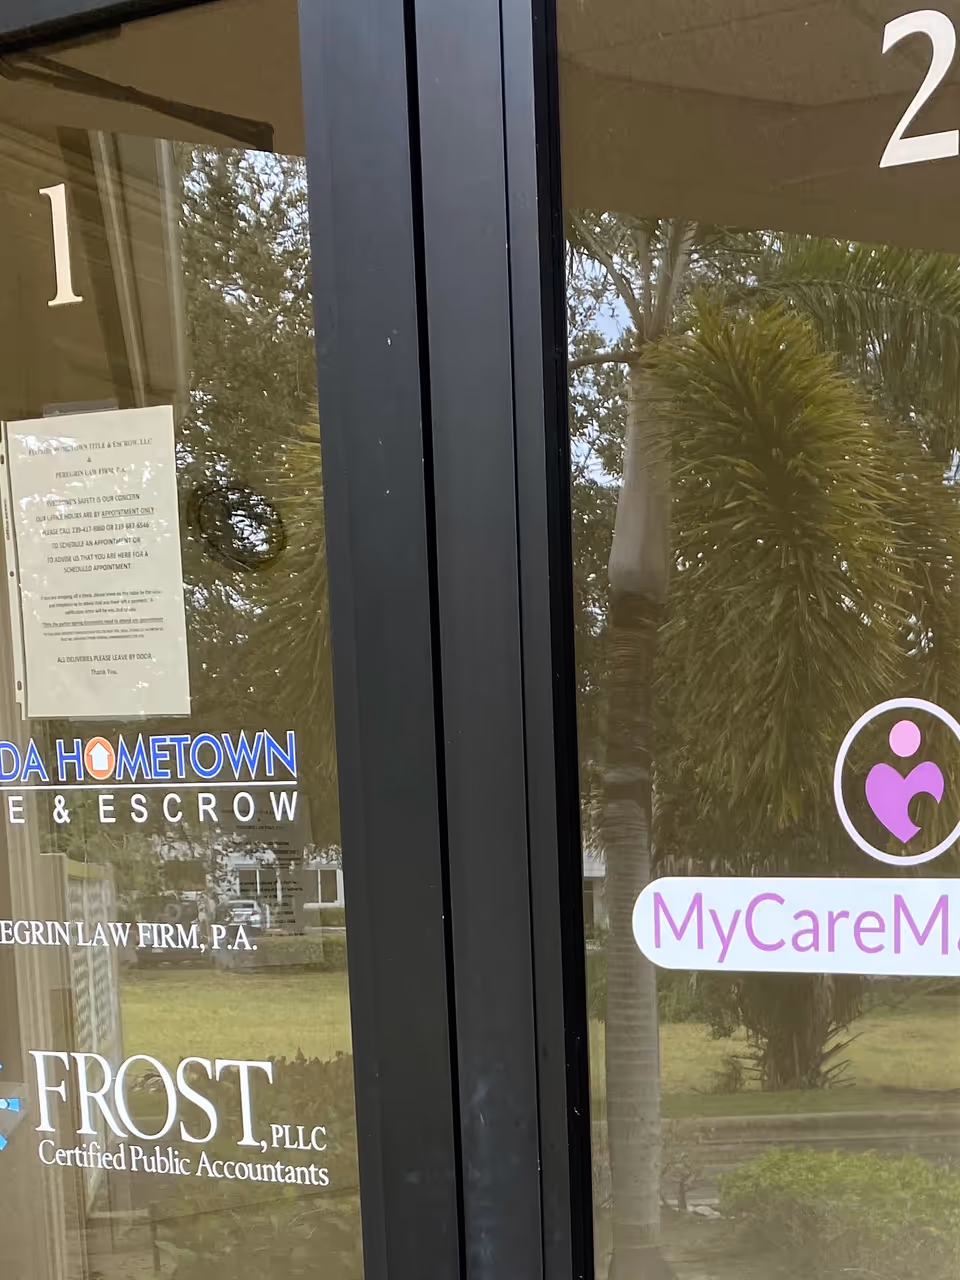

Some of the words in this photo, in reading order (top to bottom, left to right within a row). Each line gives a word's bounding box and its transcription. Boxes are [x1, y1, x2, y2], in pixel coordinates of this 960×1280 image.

[879, 9, 960, 169] 2
[38, 182, 83, 307] 1
[78, 496, 95, 504] SAFETY
[115, 493, 140, 501] CONCERN
[60, 541, 84, 549] SCHEDULE
[86, 539, 93, 547] AN
[118, 551, 131, 559] HERE
[133, 550, 143, 558] FOR
[93, 562, 131, 571] APPOINTMENT
[94, 654, 111, 662] PLEASE
[112, 653, 128, 661] LEAVE
[56, 729, 298, 783] HOMETOWN
[53, 795, 71, 824] &
[98, 791, 298, 824] ESCROW
[76, 921, 132, 947] LAW
[136, 923, 205, 953] FIRM,
[211, 924, 258, 951] P.A.
[28, 1049, 273, 1153] FROST,
[270, 1123, 328, 1151] PLLC
[38, 1139, 127, 1171] Certified
[129, 1145, 191, 1176] Public
[195, 1150, 330, 1187] Accountants
